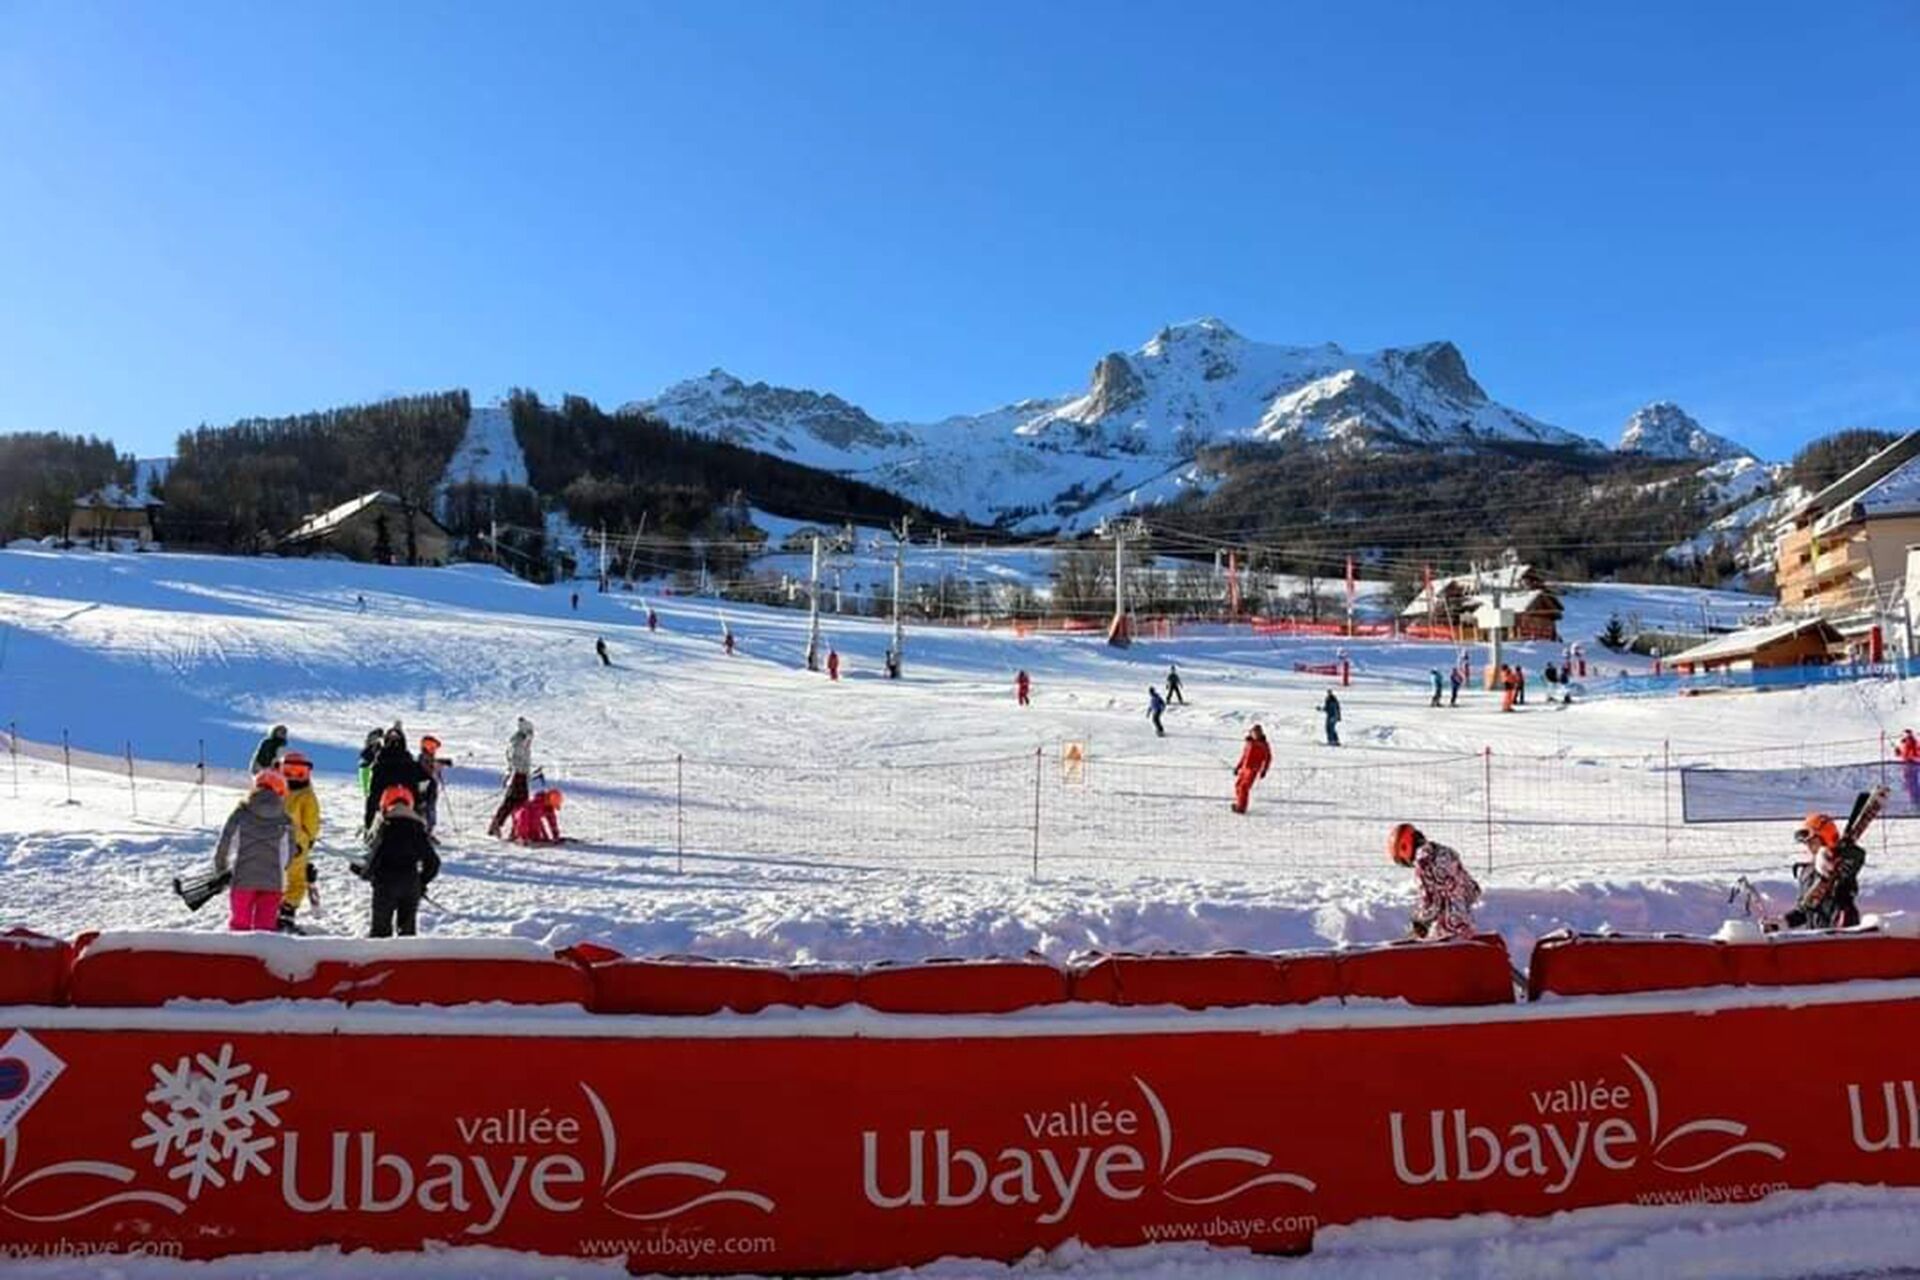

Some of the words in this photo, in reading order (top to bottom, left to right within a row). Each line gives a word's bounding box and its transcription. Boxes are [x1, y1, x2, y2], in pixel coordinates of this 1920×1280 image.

[1531, 1079, 1630, 1115] vallée
[457, 1108, 580, 1144] vallée
[1024, 1102, 1137, 1138] vallée
[1389, 1108, 1638, 1193] Ubaye
[281, 1131, 585, 1235] Ubaye
[862, 1129, 1145, 1224] Ubaye
[1141, 1215, 1318, 1239] www.ubaye.com
[579, 1231, 776, 1260] www.ubaye.com
